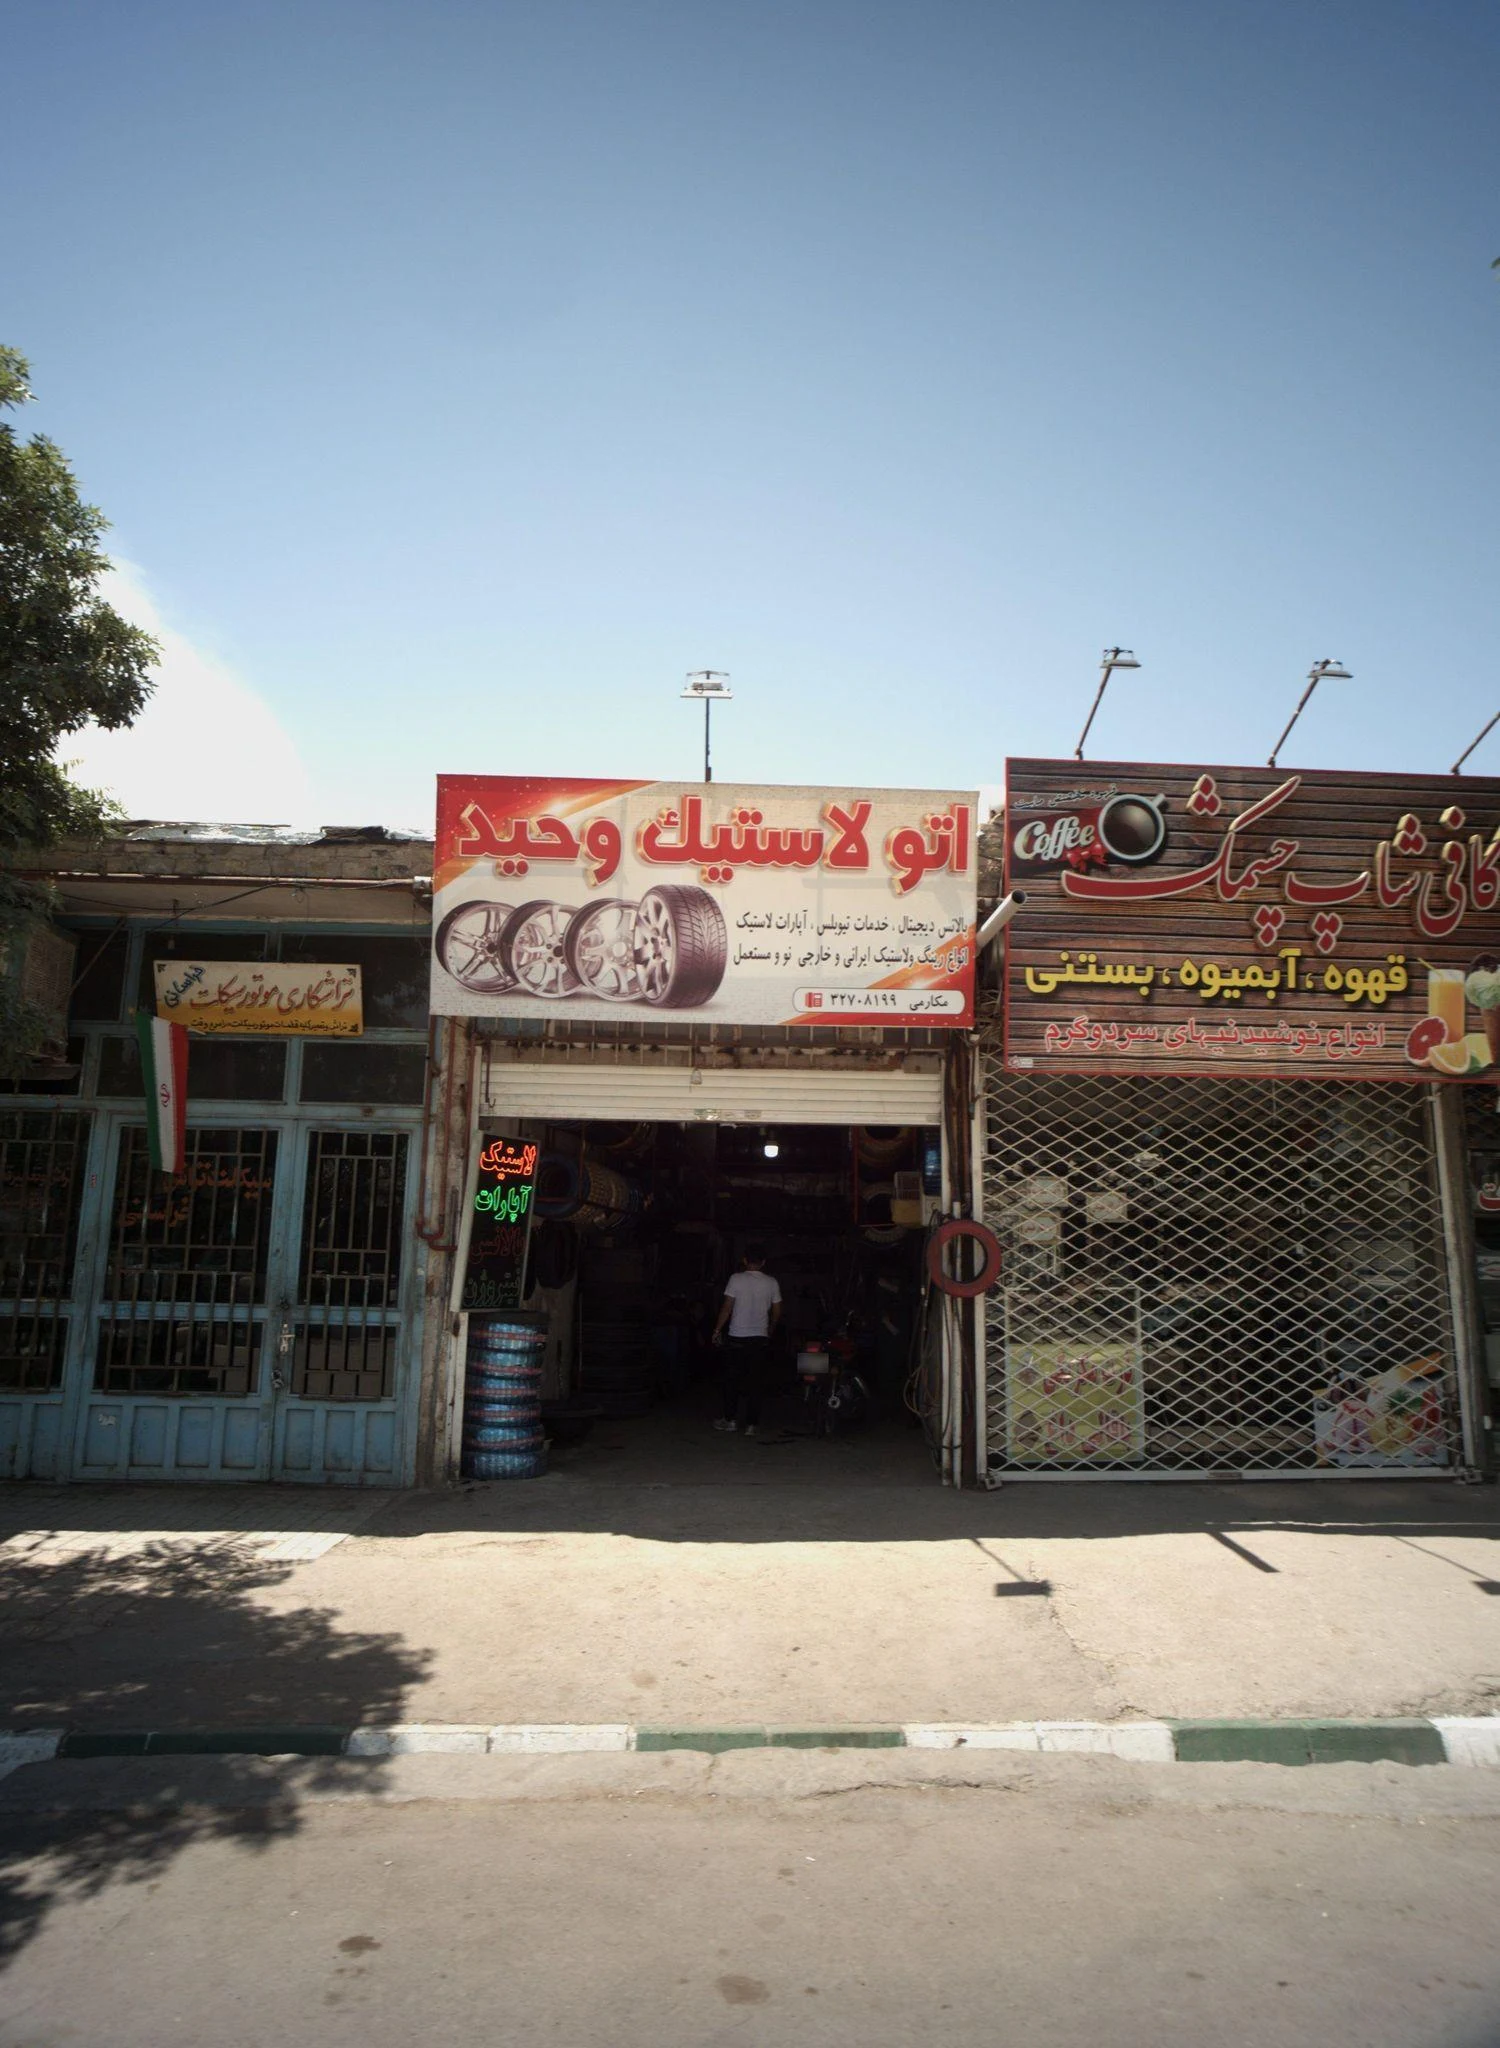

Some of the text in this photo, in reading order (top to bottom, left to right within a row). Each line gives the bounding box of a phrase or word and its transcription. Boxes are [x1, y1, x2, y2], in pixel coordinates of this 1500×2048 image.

[456, 800, 623, 887] وحید
[885, 802, 971, 896] اتو
[1013, 815, 1097, 862] Coffee
[1284, 813, 1427, 954] شاپ
[1416, 805, 1500, 937] کافی
[736, 911, 772, 932] لاستیک
[776, 909, 808, 938] آپارات
[853, 916, 889, 933] خدمات
[938, 915, 969, 940] بالانس
[733, 943, 772, 966] مستعمل
[783, 951, 793, 966] نو
[798, 944, 832, 968] خارجی
[843, 945, 871, 969] ایرانی
[945, 946, 969, 974] انواع
[164, 965, 206, 1009] خراسانی
[1025, 951, 1155, 997] بستنی
[830, 993, 950, 1011] مکارمی ۳۲۷۰۸۱۹۹
[1324, 1021, 1386, 1061] انواع
[479, 1140, 537, 1181] لاستیک
[474, 1185, 533, 1223] آپارات
